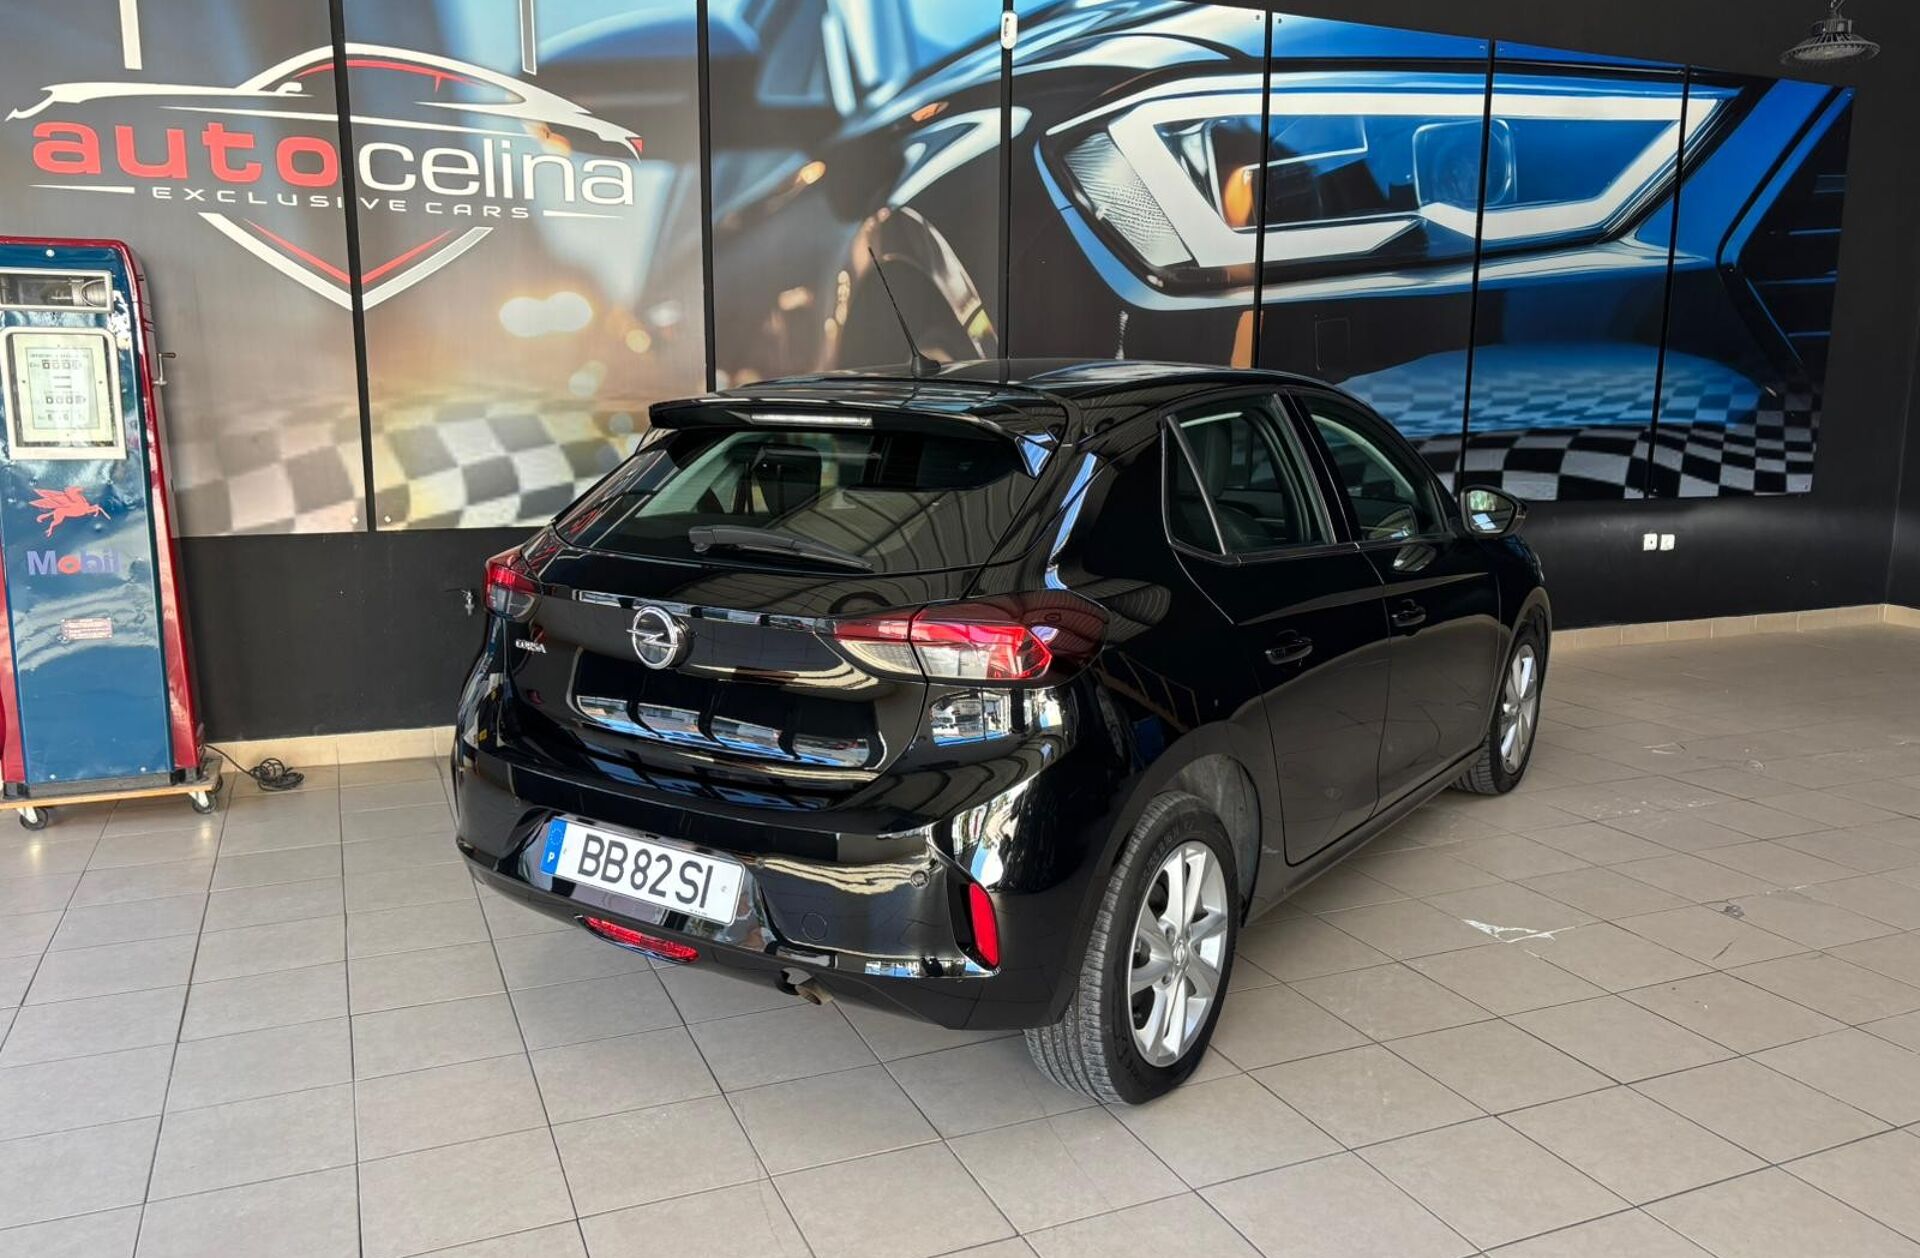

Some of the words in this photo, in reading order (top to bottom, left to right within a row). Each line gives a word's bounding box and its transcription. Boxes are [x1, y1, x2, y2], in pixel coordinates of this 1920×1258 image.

[152, 186, 408, 212] EXCLUSIVE
[425, 202, 530, 218] CARS
[26, 549, 121, 576] Mobil
